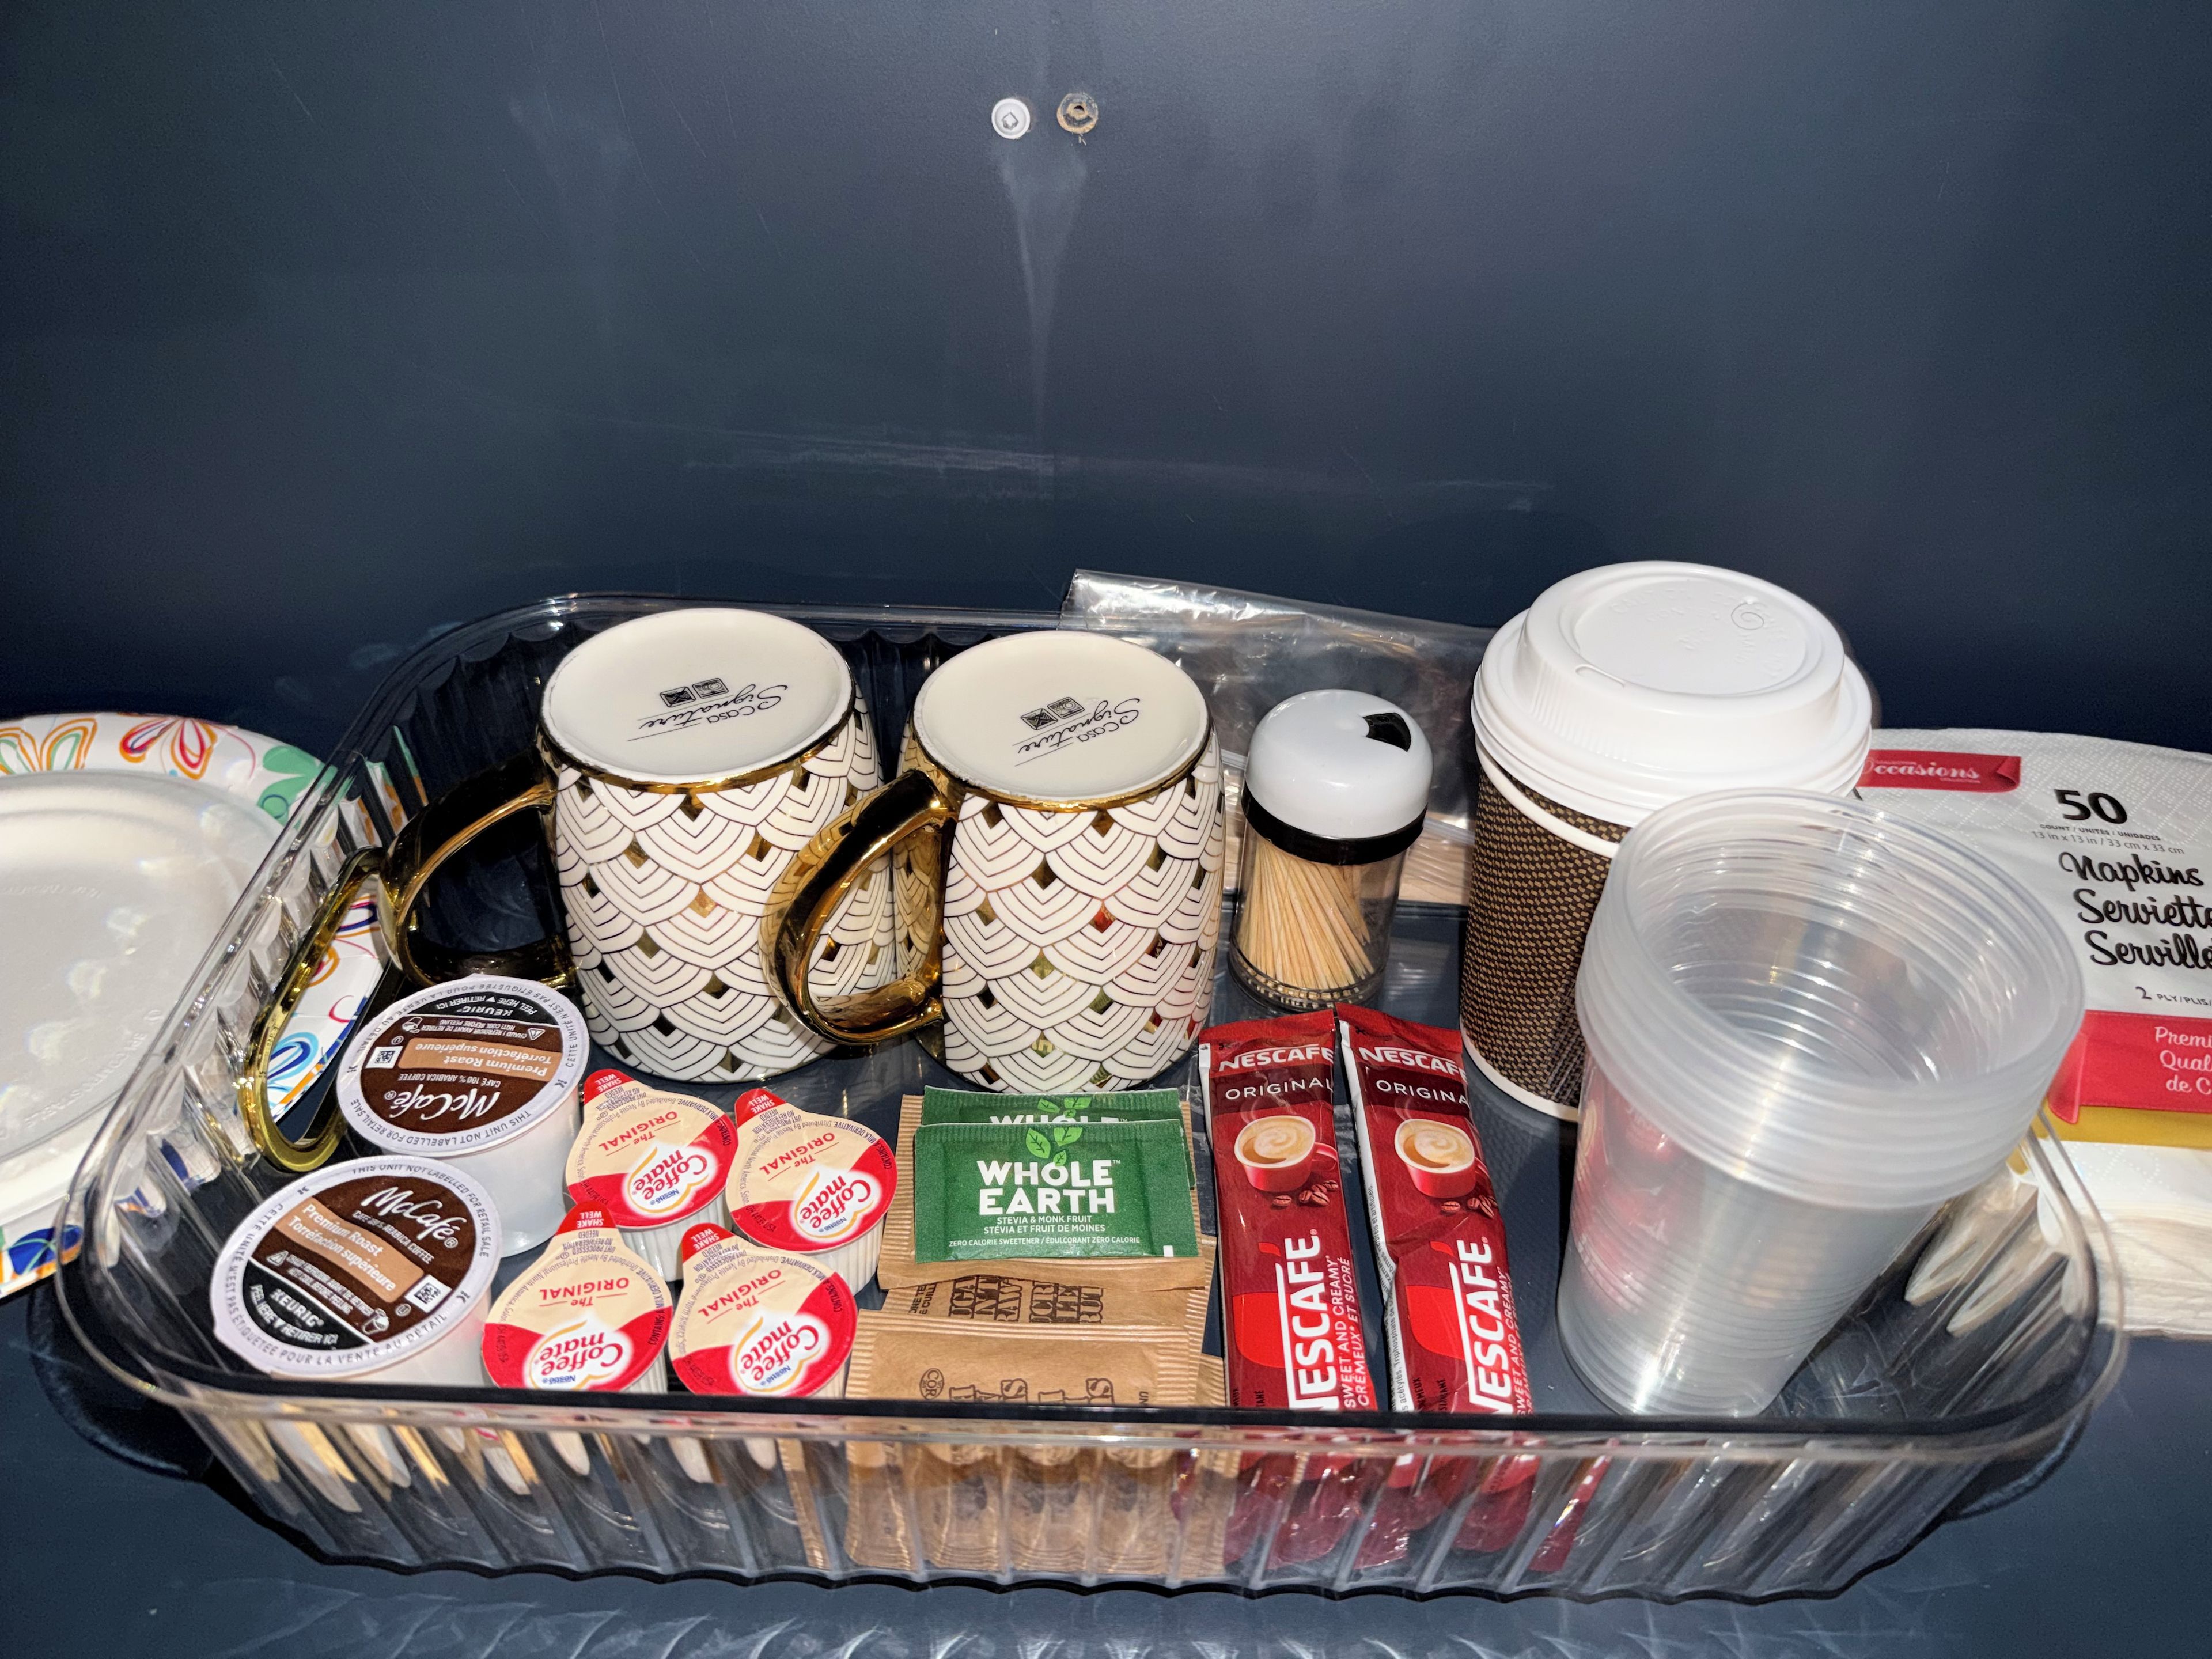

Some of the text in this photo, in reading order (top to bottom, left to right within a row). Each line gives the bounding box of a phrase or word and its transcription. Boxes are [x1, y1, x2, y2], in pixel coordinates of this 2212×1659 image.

[639, 684, 788, 729] Signature
[1018, 698, 1140, 753] Signature
[2054, 789, 2127, 824] 50
[2032, 831, 2045, 839] 13
[2047, 832, 2059, 840] in
[2071, 835, 2084, 843] 13
[2086, 836, 2097, 844] in
[2124, 842, 2141, 850] cm
[2152, 844, 2165, 852] 33
[2118, 831, 2161, 841] UNIDADES
[2058, 851, 2204, 892] Napkins
[430, 990, 443, 999] LA
[450, 995, 486, 1008] RETIRER
[497, 998, 520, 1007] HERE
[535, 991, 548, 1003] PAS
[2135, 986, 2152, 1000] 2
[396, 998, 427, 1016] VENTE
[461, 1006, 513, 1017] KEURIG
[520, 1002, 538, 1015] PEEL
[382, 1016, 394, 1026] AU
[563, 1020, 578, 1044] UNITÉ
[415, 1043, 551, 1064] Torréfaction supérieure
[566, 1043, 578, 1067] CETTE
[444, 1056, 548, 1077] Premium Roast
[595, 1073, 616, 1085] WELL
[597, 1078, 622, 1092] SHAKE
[2166, 1075, 2192, 1092] de
[389, 1084, 501, 1120] McCafé
[748, 1094, 770, 1107] WELL
[751, 1099, 775, 1114] SHAKE
[350, 1099, 532, 1146] THIS UNIT NOT LABELLED FOR RETAIL SALE
[598, 1111, 679, 1151] ORIGINAL
[634, 1130, 656, 1145] The
[759, 1132, 836, 1175] ORIGINAL
[794, 1154, 816, 1168] The
[406, 1165, 428, 1173] NOT
[634, 1150, 684, 1191] mate
[642, 1154, 707, 1200] Coffee
[977, 1160, 1113, 1187] WHOLE
[467, 1192, 482, 1207] FOR
[800, 1175, 847, 1219] mate
[811, 1179, 872, 1229] Coffee
[979, 1188, 1115, 1215] EARTH
[360, 1187, 467, 1241] McCafé
[477, 1208, 491, 1235] RETAIL
[576, 1219, 604, 1228] SHAKE
[579, 1210, 603, 1219] WELL
[997, 1216, 1028, 1224] STEVIA
[302, 1203, 384, 1257] Premium Roast
[692, 1228, 714, 1243] WELL
[984, 1224, 1015, 1234] STÉVIA
[1018, 1225, 1028, 1233] ET
[1092, 1235, 1109, 1243] ZÉRO
[288, 1215, 344, 1254] Torréfaction
[341, 1250, 396, 1291] supérieure
[480, 1236, 490, 1258] SALE
[692, 1233, 720, 1251] SHAKE
[252, 1202, 285, 1232] CETTE
[279, 1350, 313, 1365] POUR
[316, 1355, 332, 1365] LA
[539, 1277, 630, 1300] ORIGINAL
[1337, 1257, 1355, 1304] SUCRÉ
[571, 1297, 593, 1308] The
[697, 1270, 782, 1317] ORIGINAL
[736, 1295, 760, 1310] The
[269, 1288, 318, 1327] KEURIG
[1347, 1308, 1358, 1323] ET
[280, 1323, 323, 1344] RETIRER
[1334, 1320, 1349, 1353] AND
[540, 1332, 604, 1362] mate
[741, 1321, 793, 1370] mate
[751, 1325, 819, 1381] Coffee
[1507, 1335, 1518, 1363] AND
[541, 1343, 623, 1375] Coffee
[1339, 1358, 1357, 1408] SWEET
[1512, 1370, 1525, 1415] SWEET
